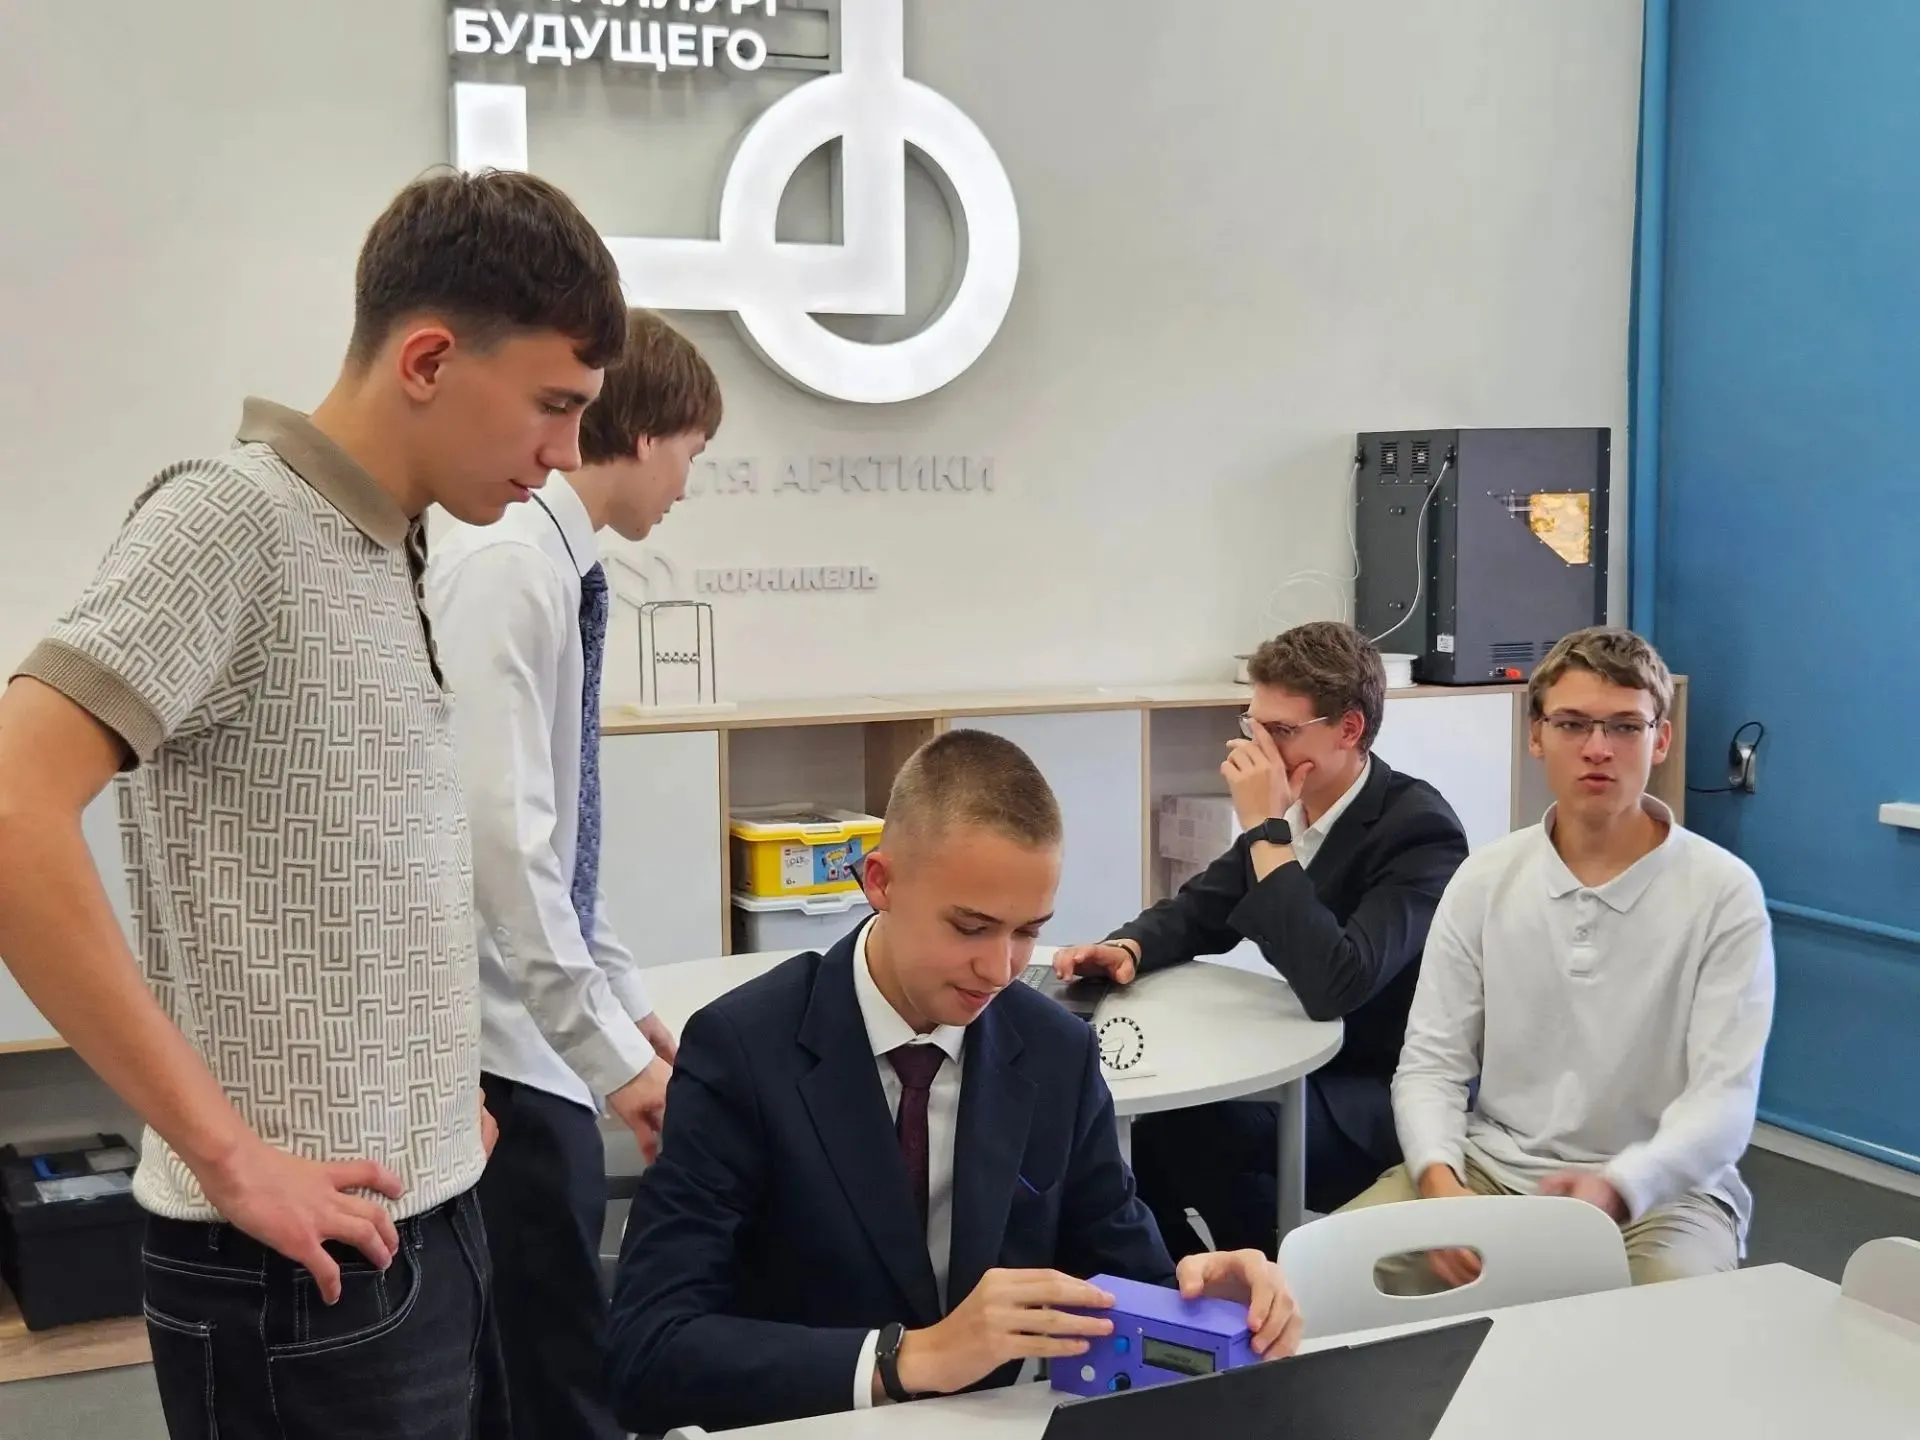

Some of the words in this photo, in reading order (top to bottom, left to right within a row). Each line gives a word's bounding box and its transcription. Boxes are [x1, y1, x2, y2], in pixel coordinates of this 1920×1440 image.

[453, 7, 768, 72] БУДУЩЕГО
[687, 456, 758, 495] ЛЯ
[772, 454, 996, 493] АРКТИКИ
[696, 566, 879, 594] НОРНИКЕЛЬ
